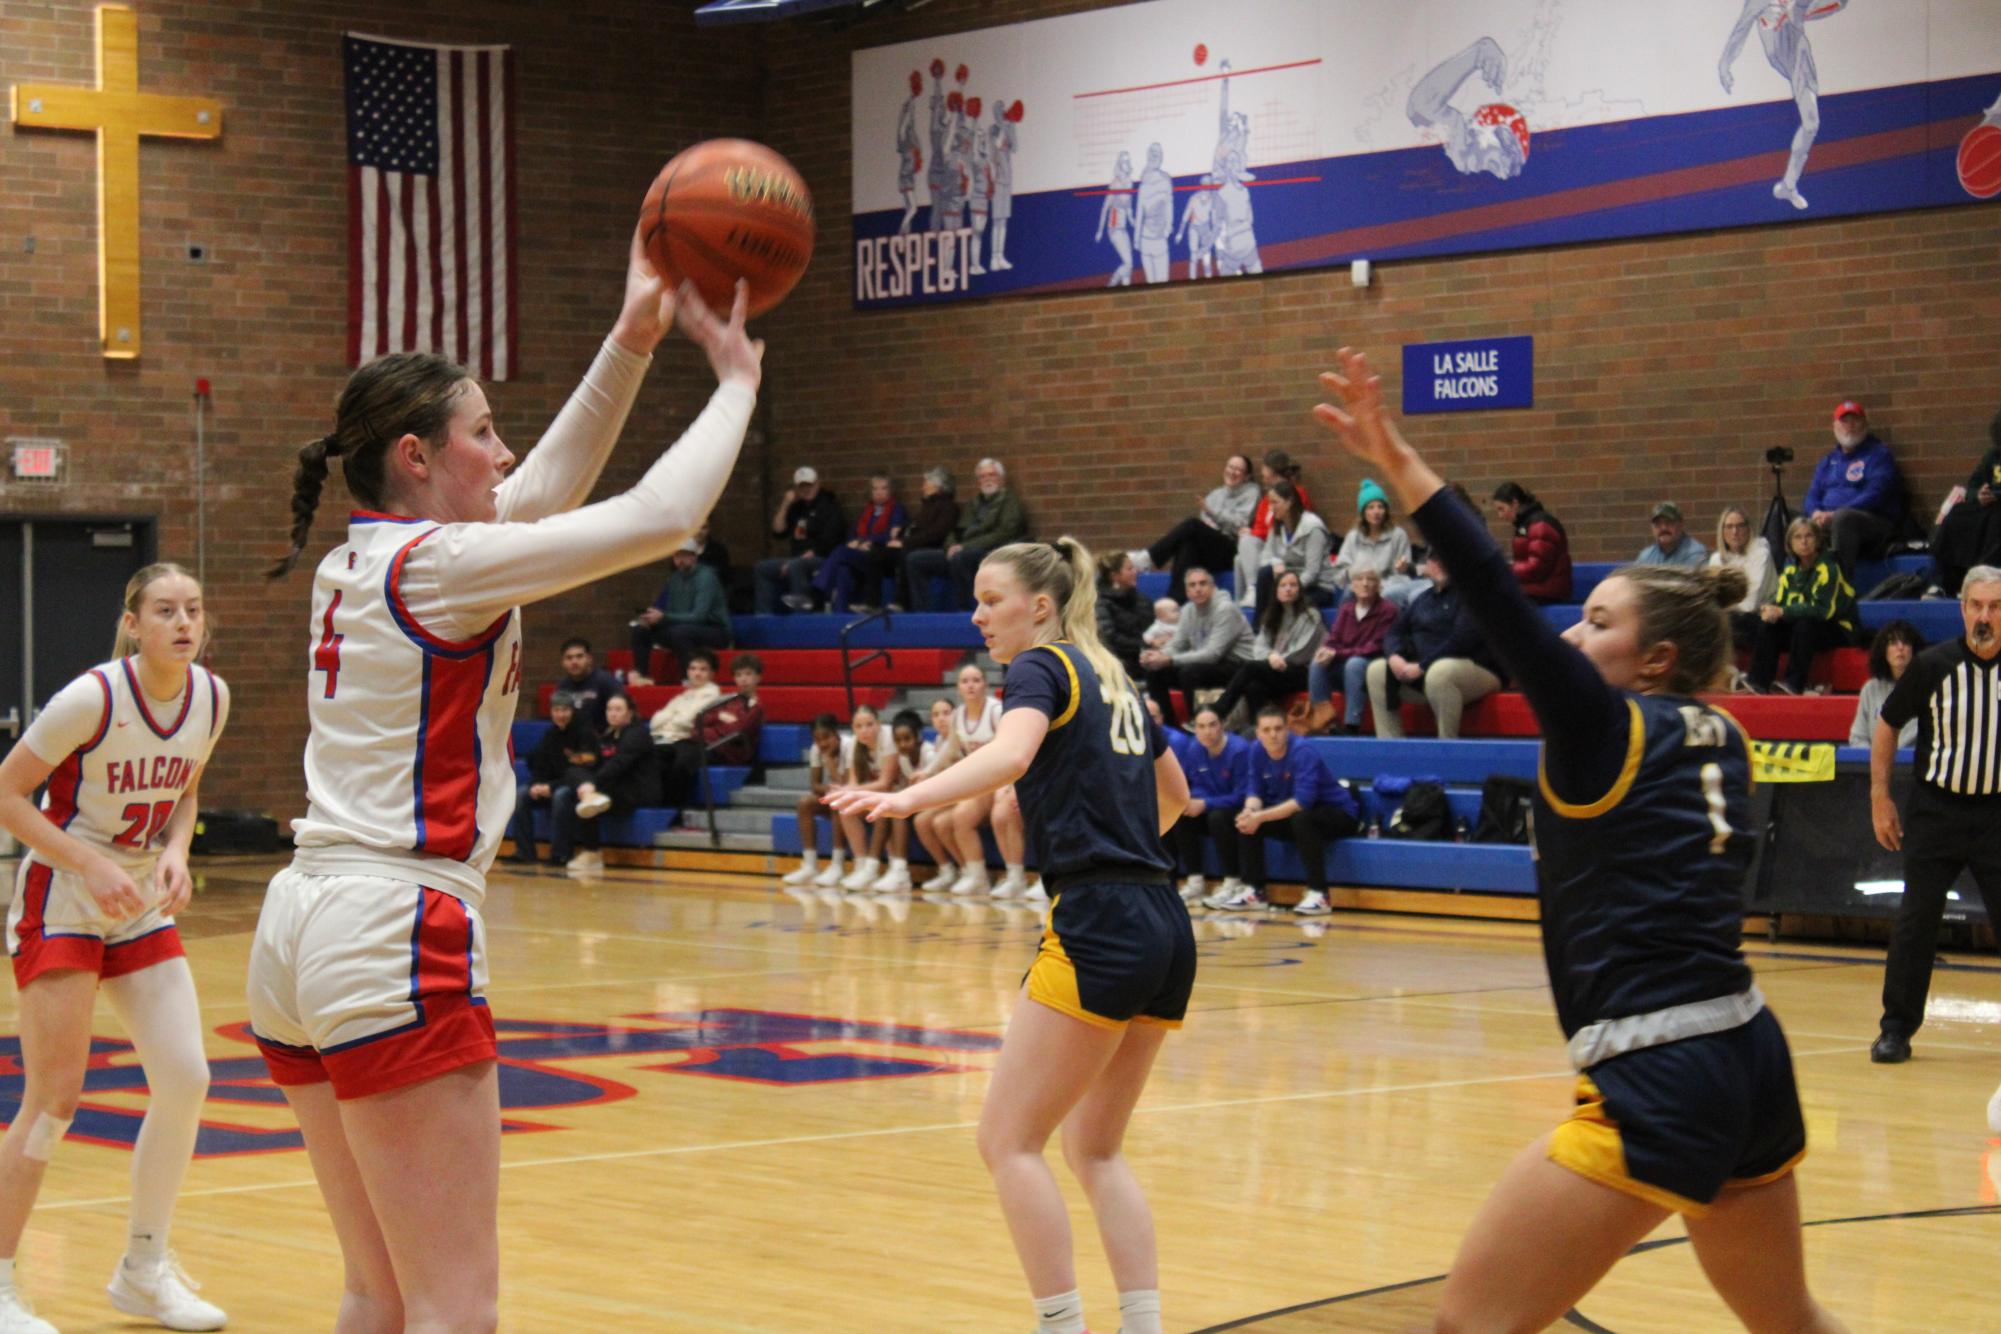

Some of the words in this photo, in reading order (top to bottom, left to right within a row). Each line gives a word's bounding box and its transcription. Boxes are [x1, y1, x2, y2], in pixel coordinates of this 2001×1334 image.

[857, 227, 973, 301] RESPECT
[1433, 353, 1454, 375] LA
[1455, 349, 1499, 373] SALLE
[1434, 374, 1499, 400] FALCONS
[314, 588, 345, 699] 4
[106, 755, 198, 794] FALCON
[1701, 762, 1734, 854] 1
